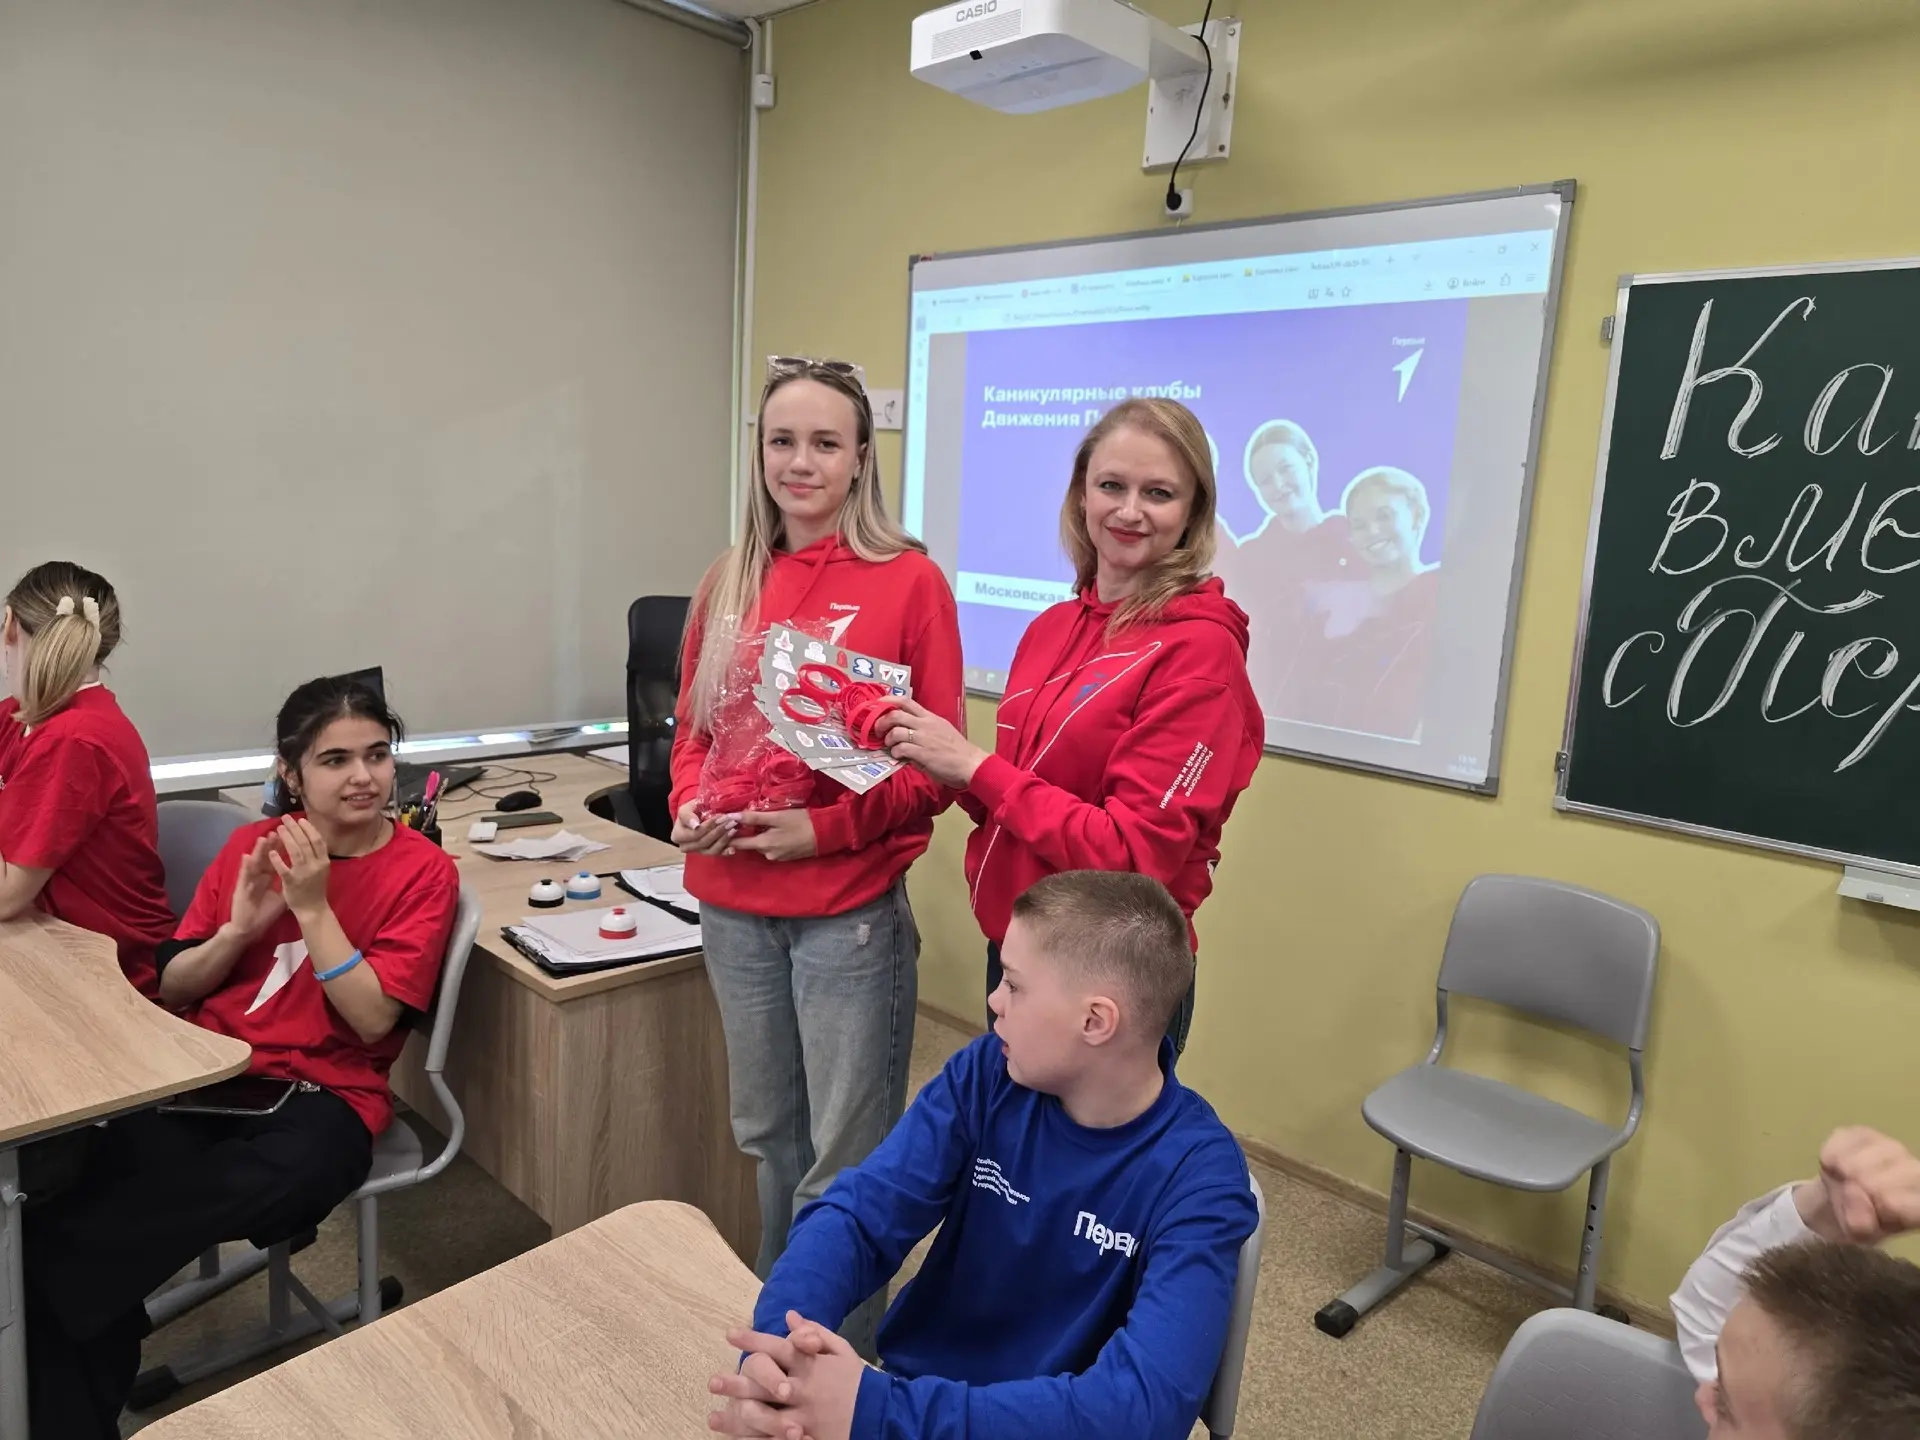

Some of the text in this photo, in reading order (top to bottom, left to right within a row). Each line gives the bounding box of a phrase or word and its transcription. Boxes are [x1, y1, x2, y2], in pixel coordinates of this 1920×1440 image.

[956, 0, 998, 22] CASIO
[1391, 336, 1427, 347] Первые
[983, 384, 1128, 406] Каникулярные
[981, 409, 1080, 429] Движения
[829, 602, 861, 612] Первые
[1181, 766, 1189, 774] и
[1184, 750, 1214, 798] Российское
